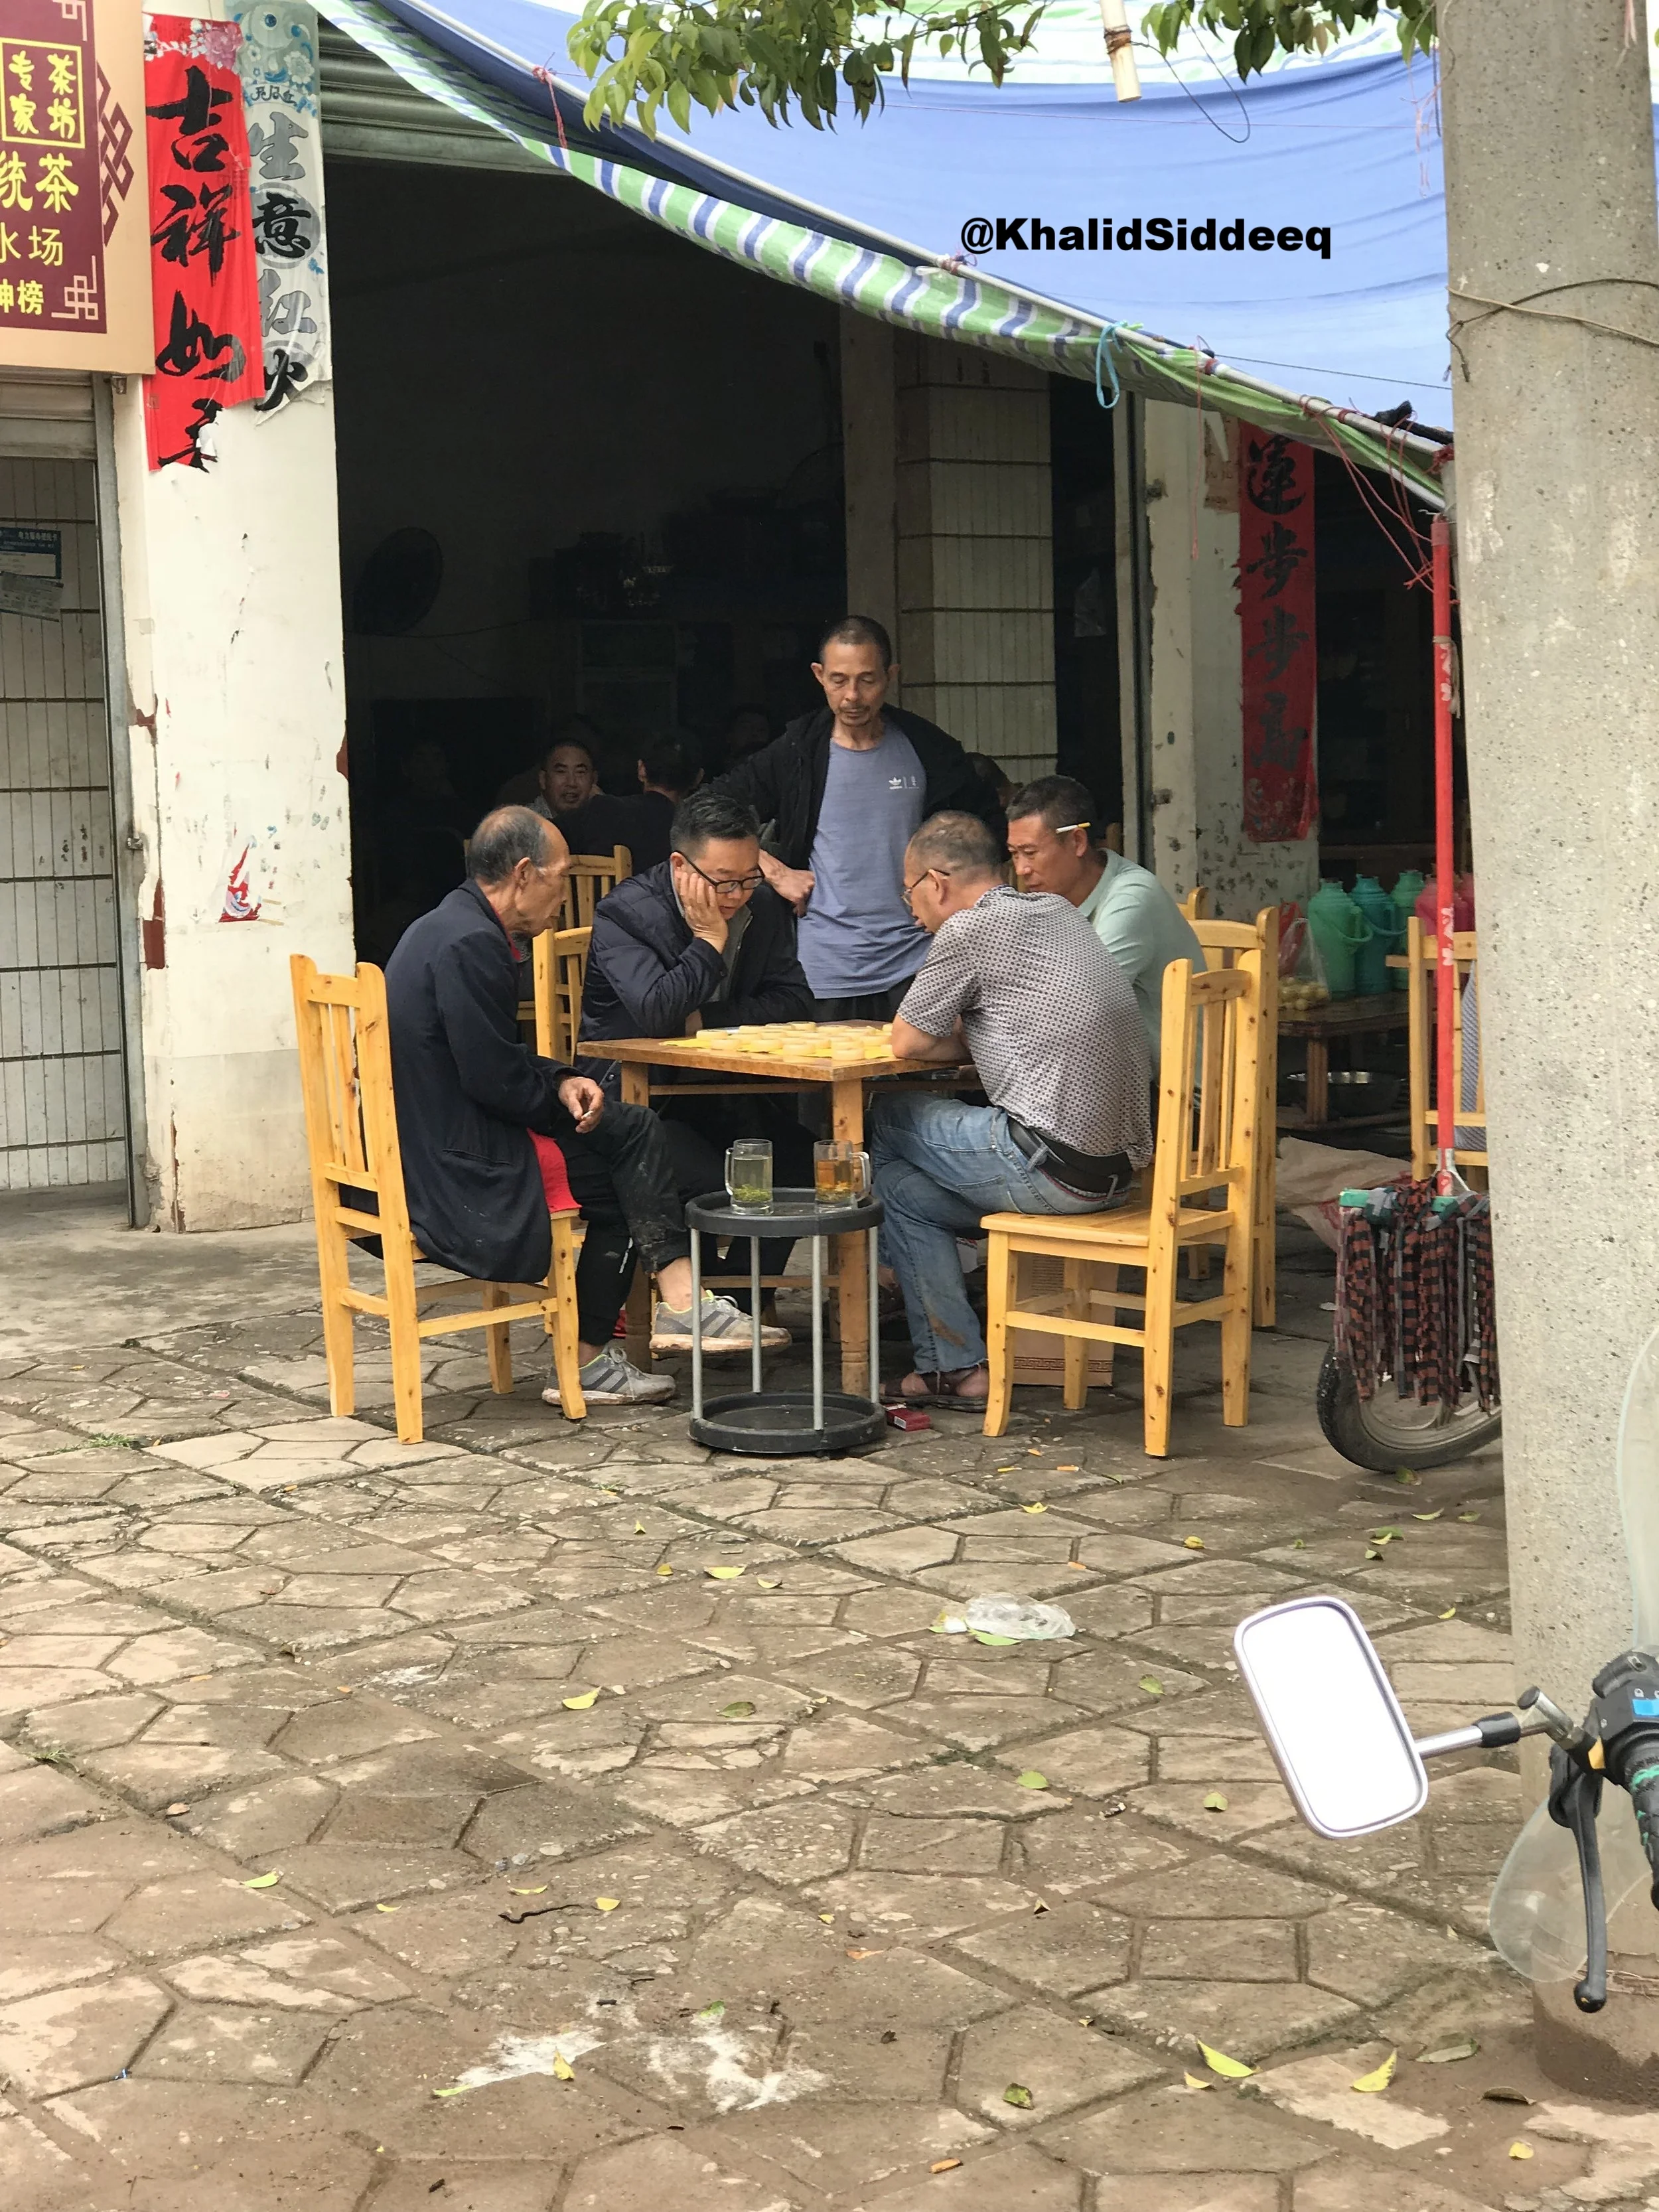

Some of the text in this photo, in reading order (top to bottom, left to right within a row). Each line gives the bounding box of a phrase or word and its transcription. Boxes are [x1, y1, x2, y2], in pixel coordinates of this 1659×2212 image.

[9, 50, 39, 135] 专家
[46, 53, 78, 139] 茶坊
[248, 111, 317, 411] 生意红火
